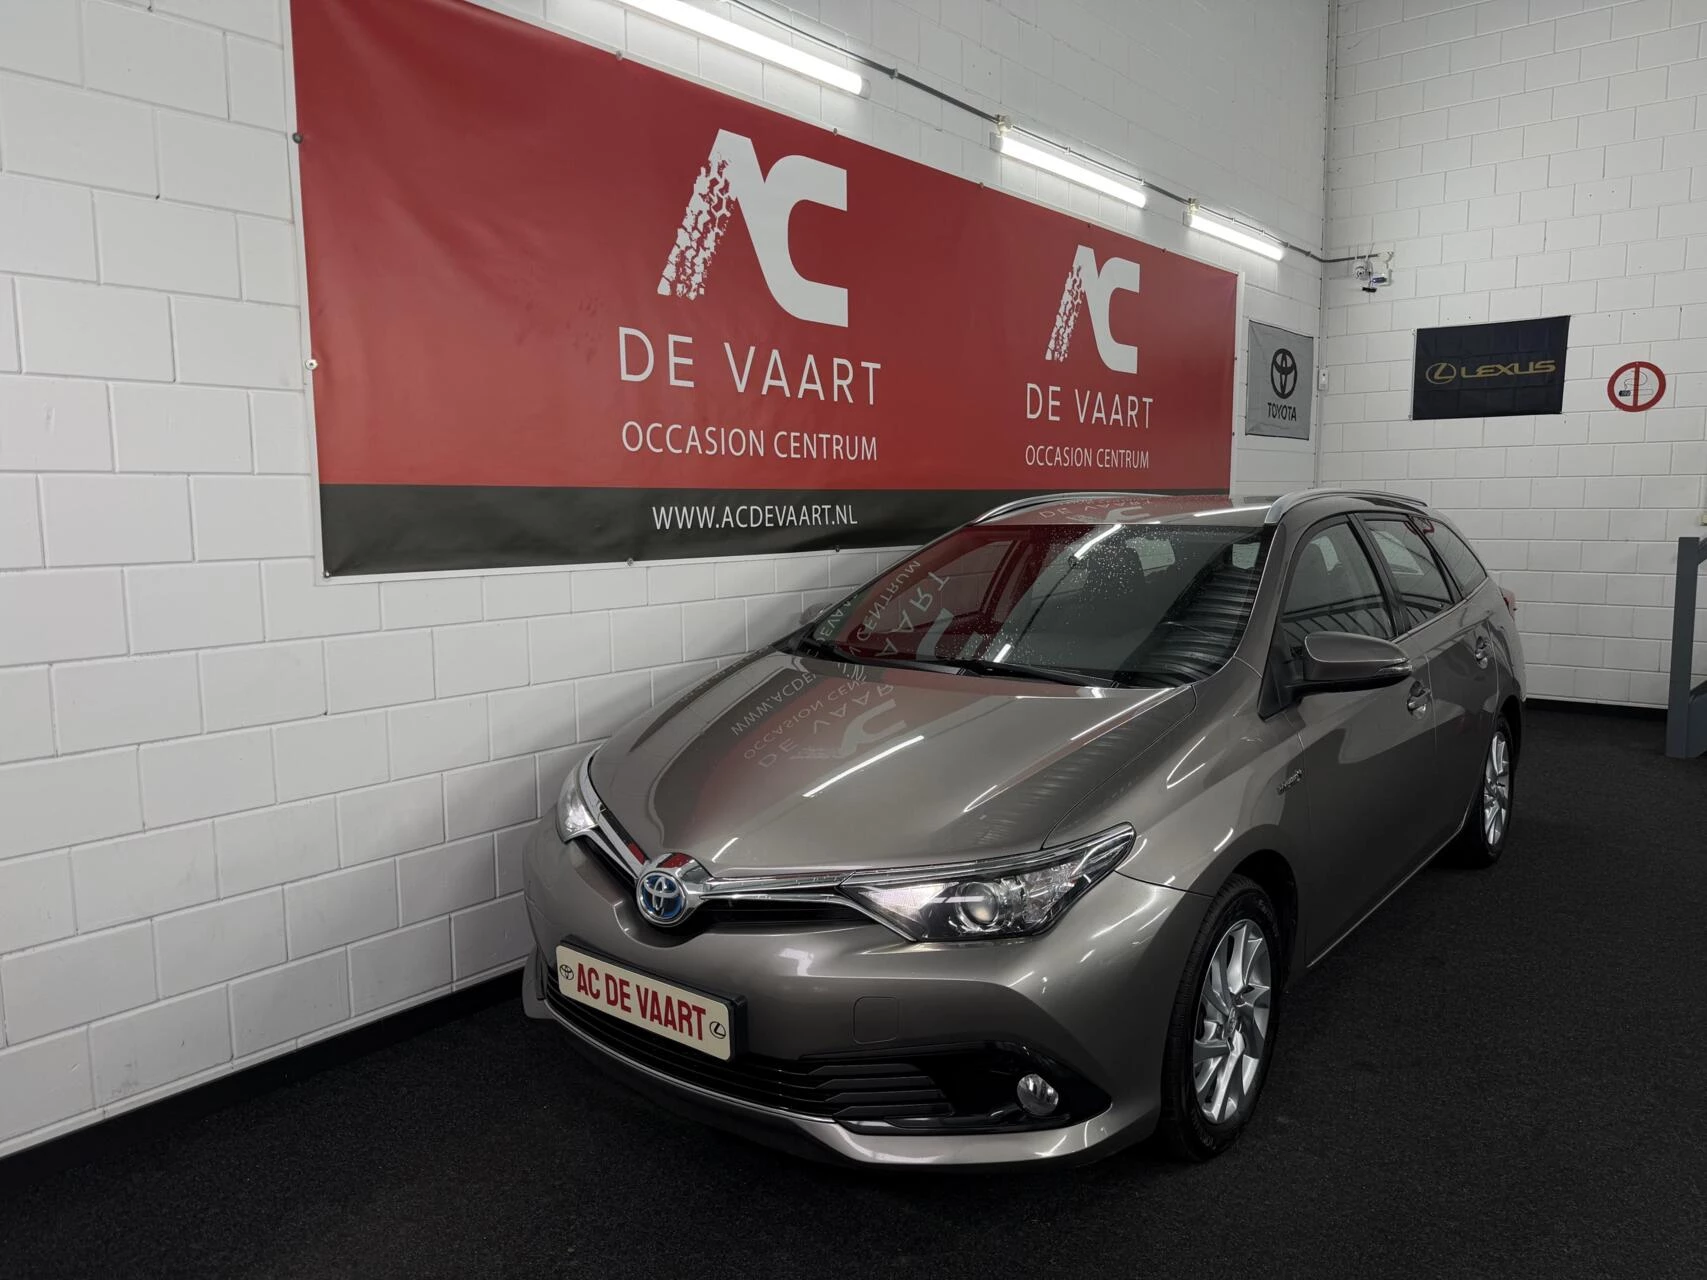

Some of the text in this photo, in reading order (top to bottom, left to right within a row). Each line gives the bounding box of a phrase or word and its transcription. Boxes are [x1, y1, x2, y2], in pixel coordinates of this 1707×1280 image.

[657, 128, 848, 328] AC
[1045, 244, 1140, 374] AC
[618, 326, 881, 405] DE VAART
[1461, 361, 1556, 378] LEXUS
[1026, 382, 1154, 429] DE VAART
[1267, 402, 1297, 422] TOYOTA
[621, 420, 878, 461] OCCASION CENTRUM
[1025, 445, 1149, 469] OCCASION CENTRUM
[652, 504, 858, 530] WWW.ACDEVAART.NL
[577, 962, 707, 1041] AC DE VAART
